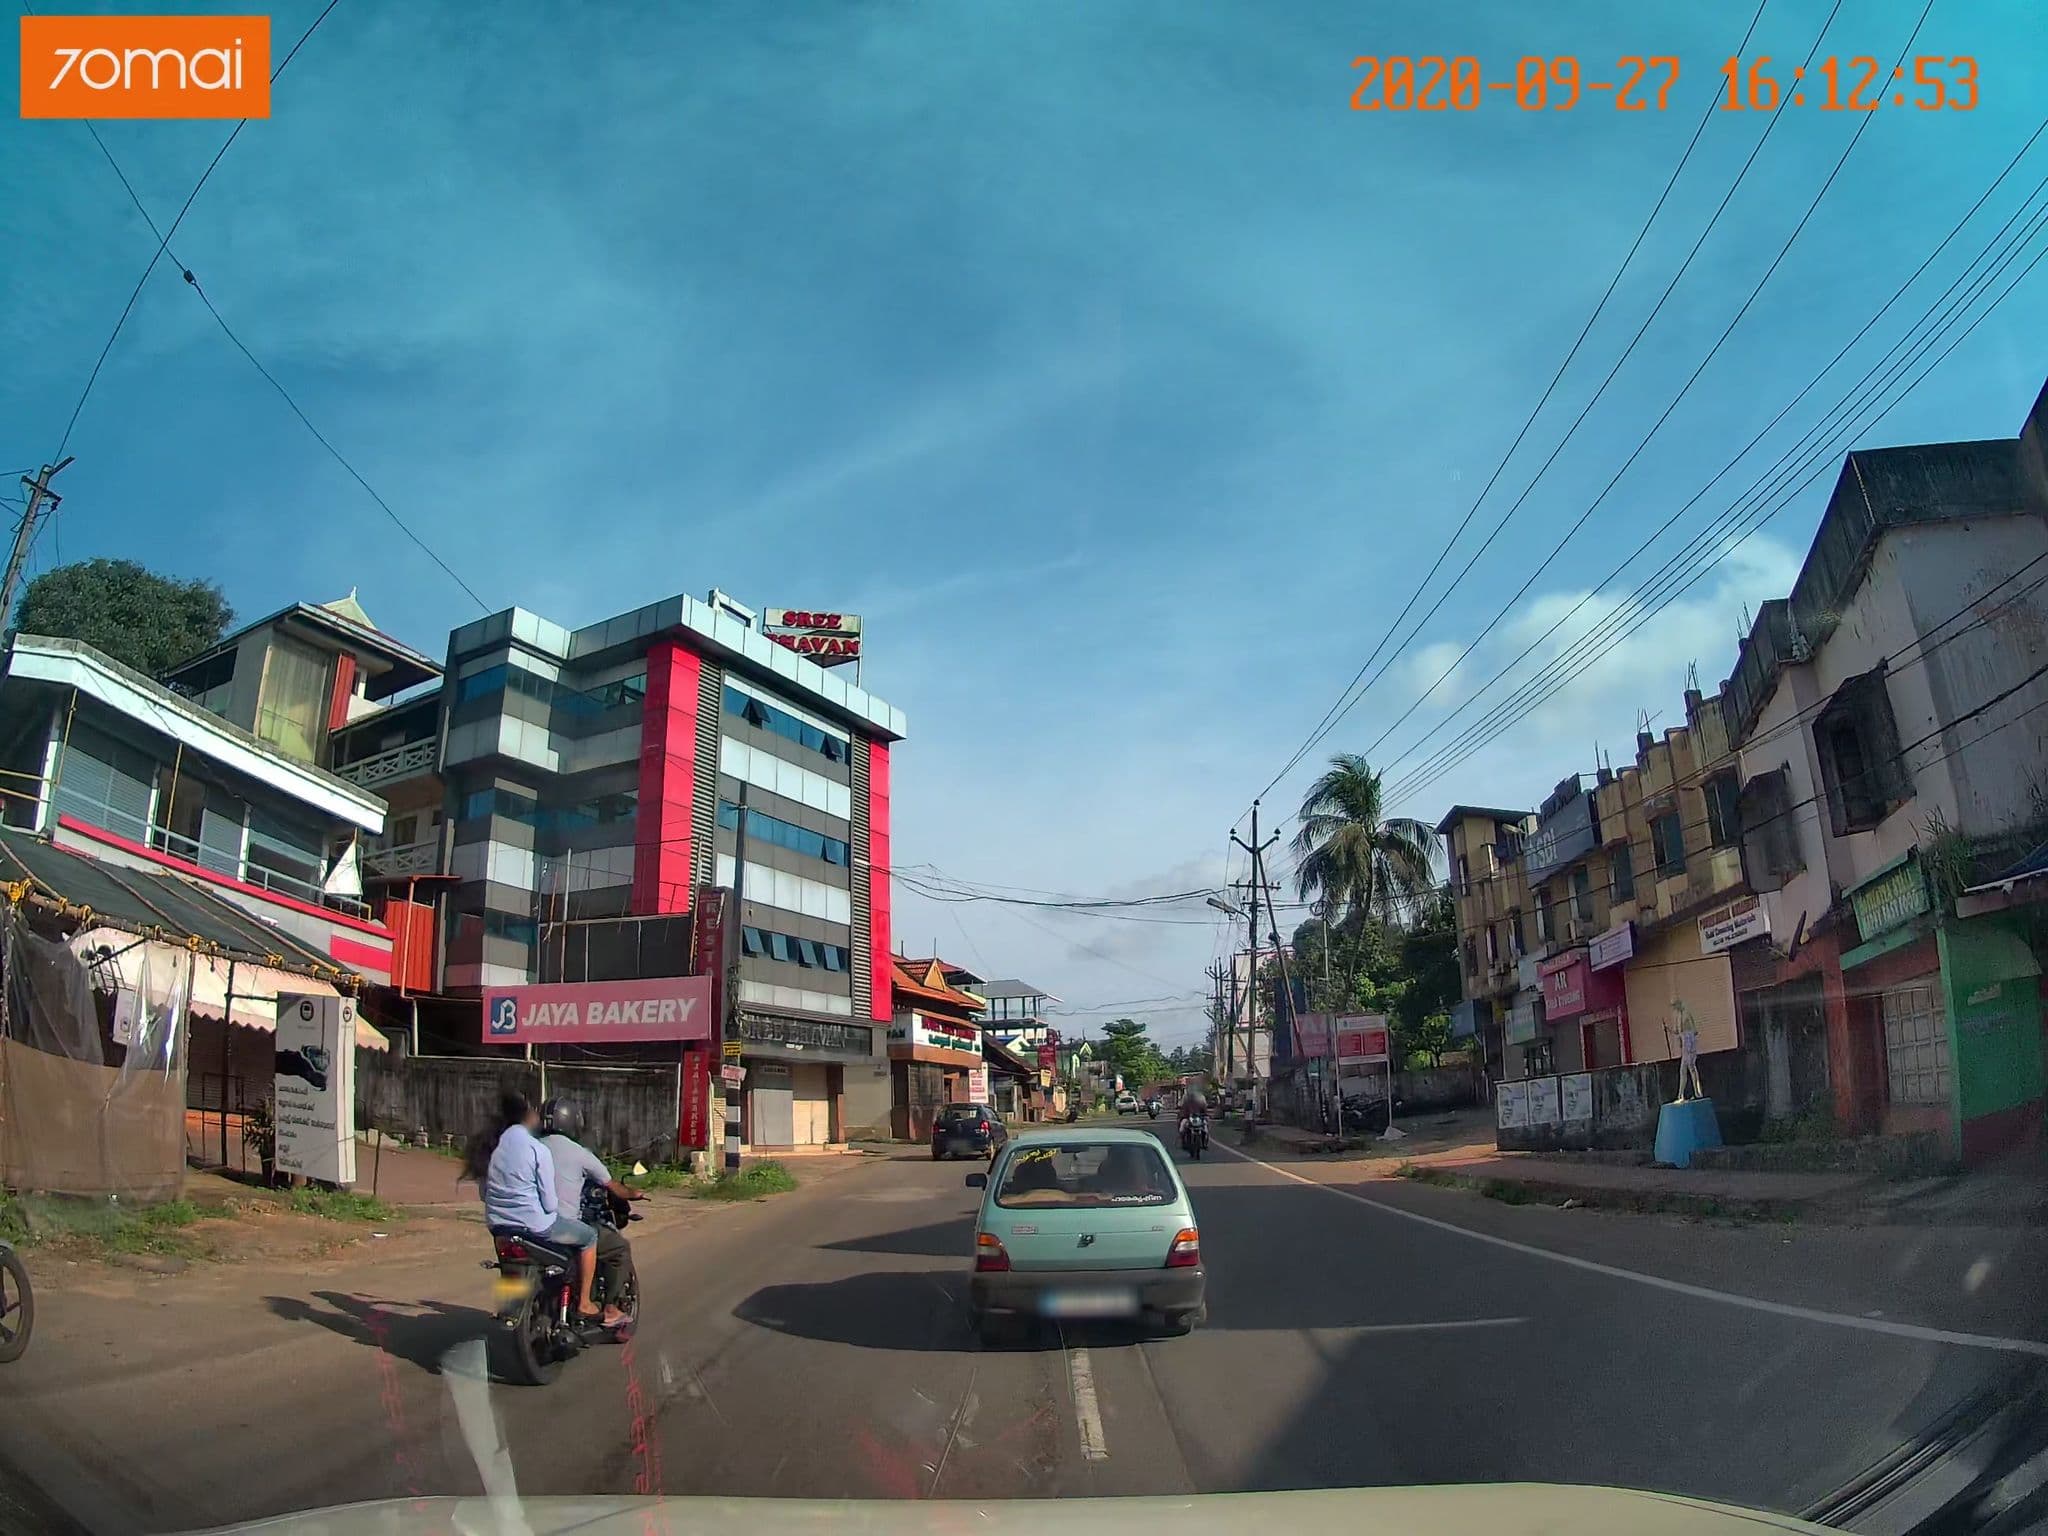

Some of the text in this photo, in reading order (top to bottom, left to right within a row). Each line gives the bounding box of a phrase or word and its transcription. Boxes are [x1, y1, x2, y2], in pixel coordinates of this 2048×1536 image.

[783, 611, 841, 629] SREE
[1554, 970, 1567, 991] AR
[521, 1002, 580, 1027] JAYA
[586, 997, 697, 1025] BAKERY
